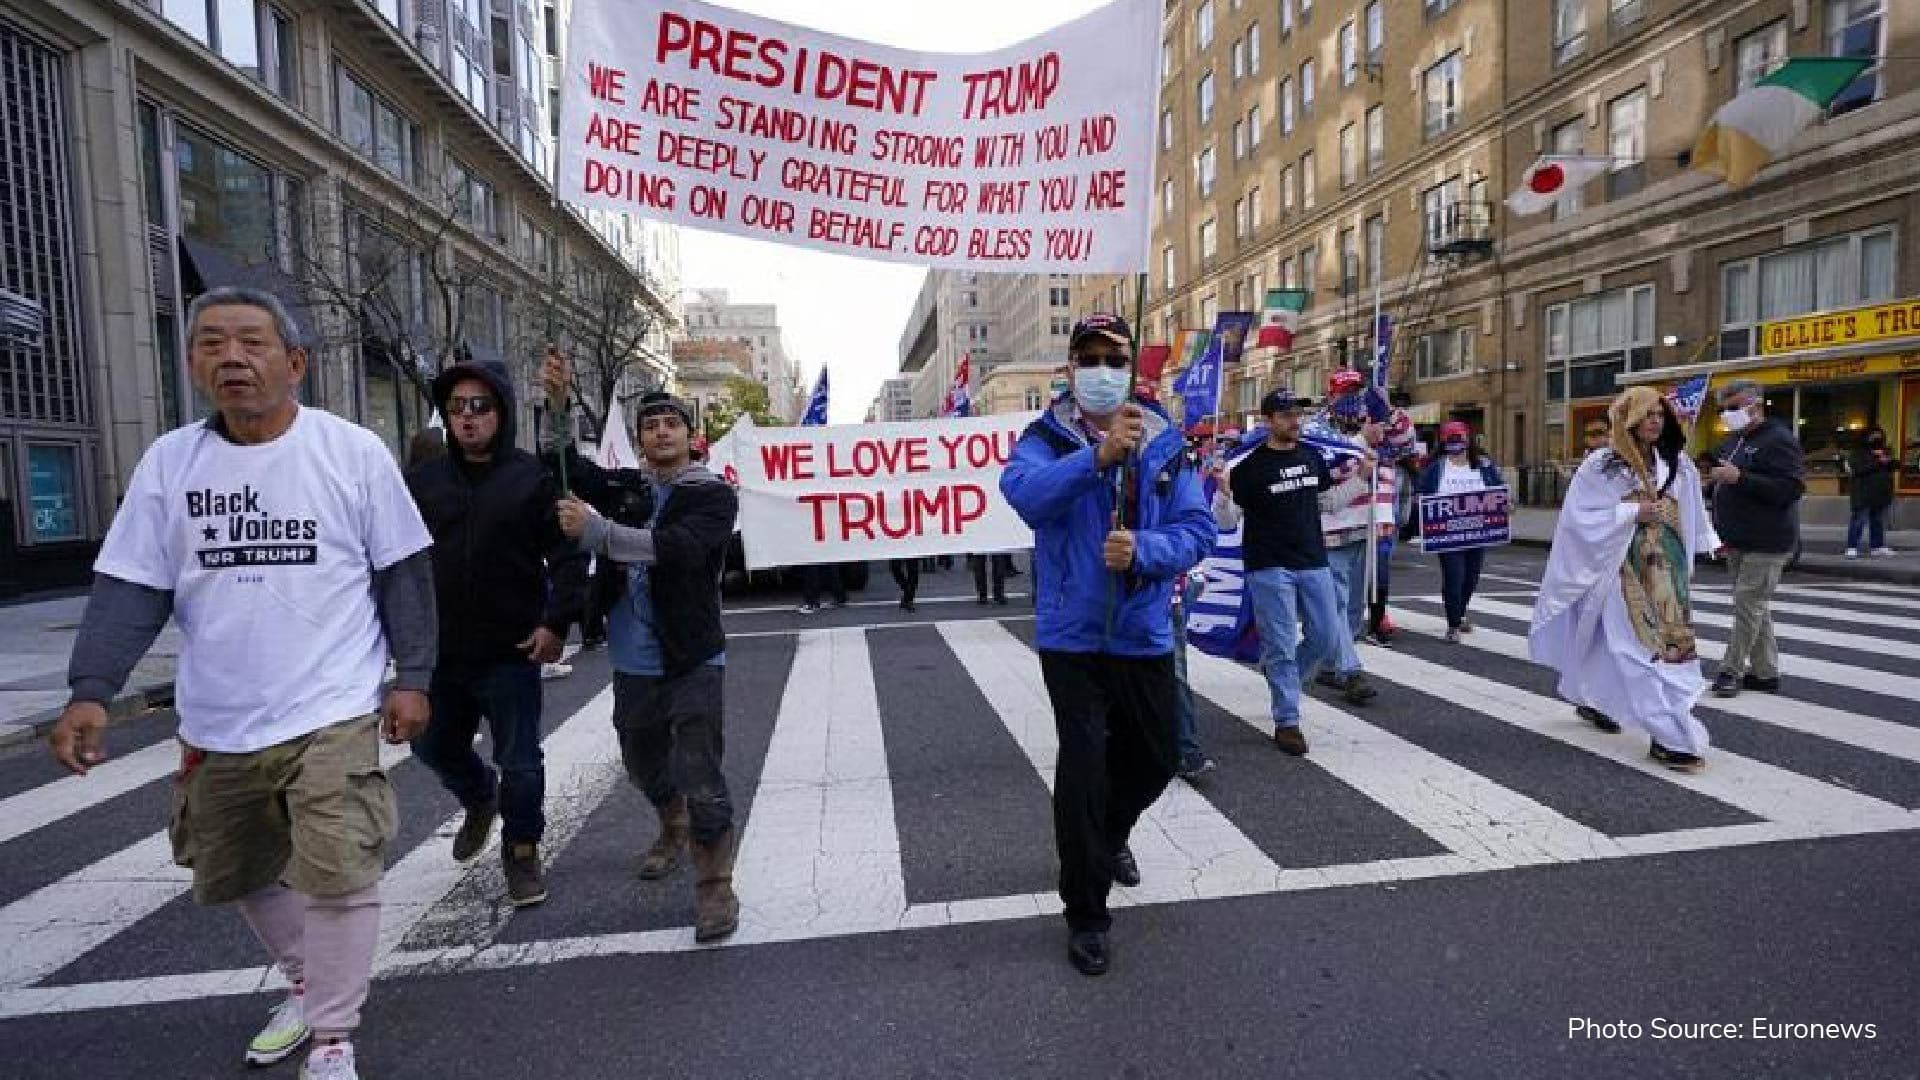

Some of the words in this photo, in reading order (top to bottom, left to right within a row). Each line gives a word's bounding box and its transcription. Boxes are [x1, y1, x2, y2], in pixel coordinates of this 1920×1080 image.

[656, 11, 937, 117] PRESIDENT
[962, 52, 1061, 120] TRUMP
[587, 63, 626, 104] WE
[641, 79, 697, 122] ARE
[717, 95, 857, 155] STANDING
[873, 129, 963, 169] STRONG
[974, 134, 1026, 168] WITH
[1036, 124, 1069, 161] YOU
[1078, 115, 1118, 154] AND
[585, 113, 641, 156] ARE
[657, 131, 766, 182] DEEPLY
[781, 158, 907, 208] GRATEFUL
[924, 180, 969, 213] FOR
[978, 180, 1031, 214] WHAT
[1039, 175, 1074, 212] YOU
[1086, 169, 1126, 211] ARE
[584, 159, 675, 211] DOING
[689, 186, 728, 218] ON
[741, 194, 796, 233] OUR
[809, 206, 908, 253] BEHALF.
[913, 225, 958, 257] GOD
[966, 228, 1031, 262] BLESS
[1044, 228, 1094, 262] YOU!
[1772, 315, 1857, 349] OLLIE'S
[761, 442, 815, 482] WE
[827, 436, 931, 478] LOVE
[938, 430, 1018, 470] YOU
[186, 485, 261, 518] Black
[227, 511, 317, 542] Voices
[796, 483, 988, 543] TRUMP
[1421, 491, 1508, 519] TRUMP
[242, 547, 312, 563] TRUMP
